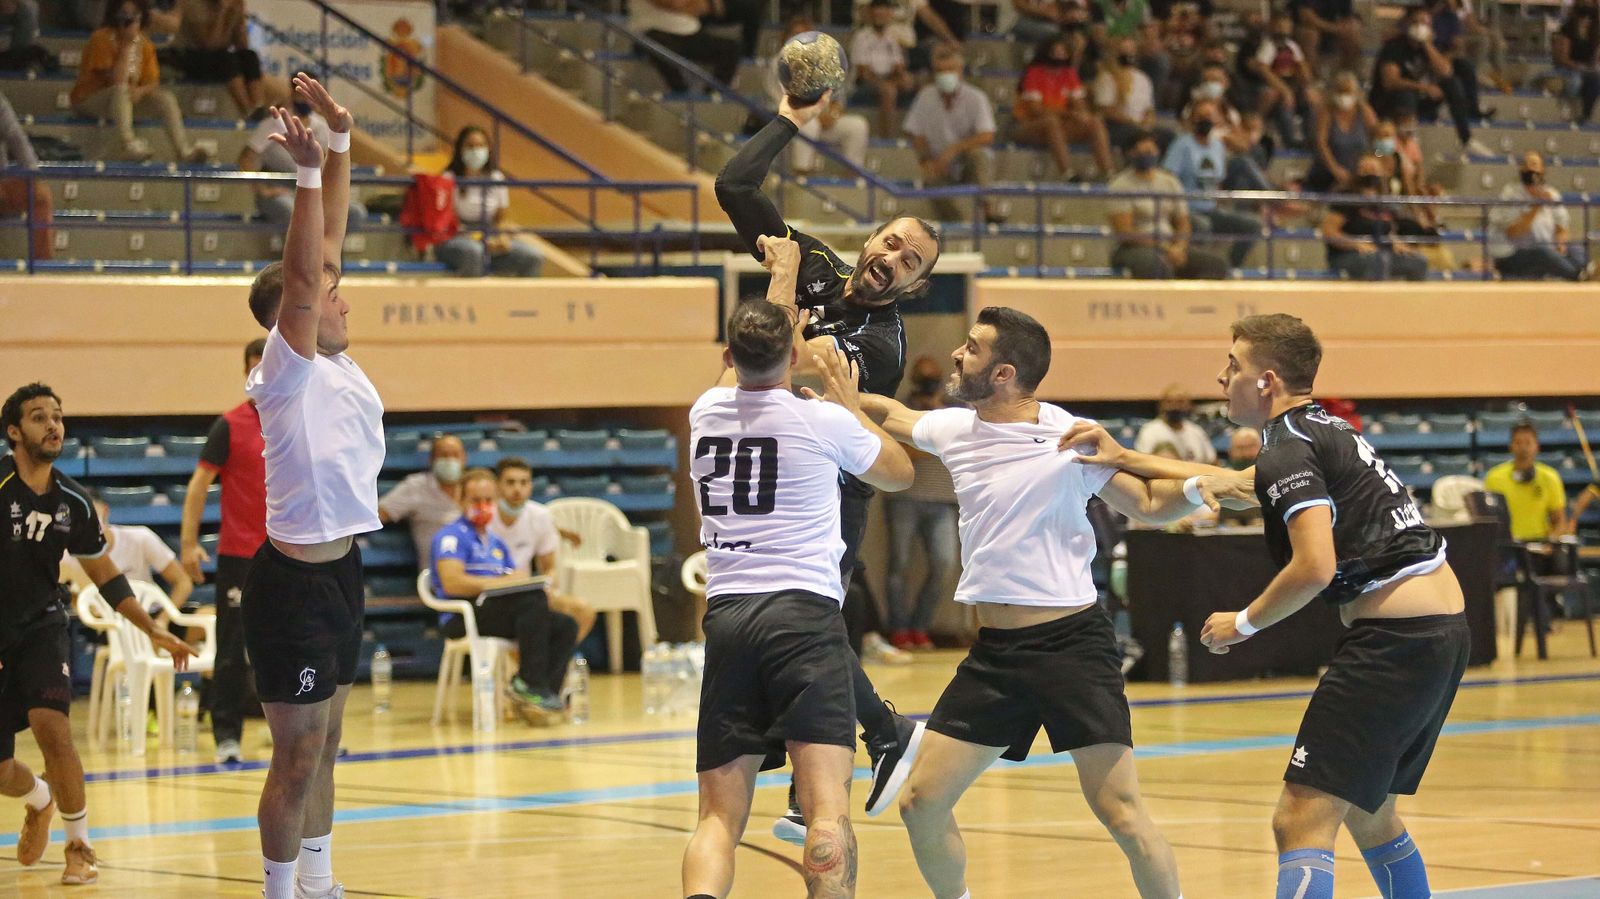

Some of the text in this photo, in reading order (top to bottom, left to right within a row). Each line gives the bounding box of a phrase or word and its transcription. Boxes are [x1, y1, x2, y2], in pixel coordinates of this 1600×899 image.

[382, 303, 478, 324] PRENSA
[1088, 302, 1165, 319] PRENSA
[695, 436, 778, 516] 20
[1277, 470, 1314, 487] Diputación
[1281, 479, 1310, 495] de Cádiz
[25, 510, 52, 542] 17
